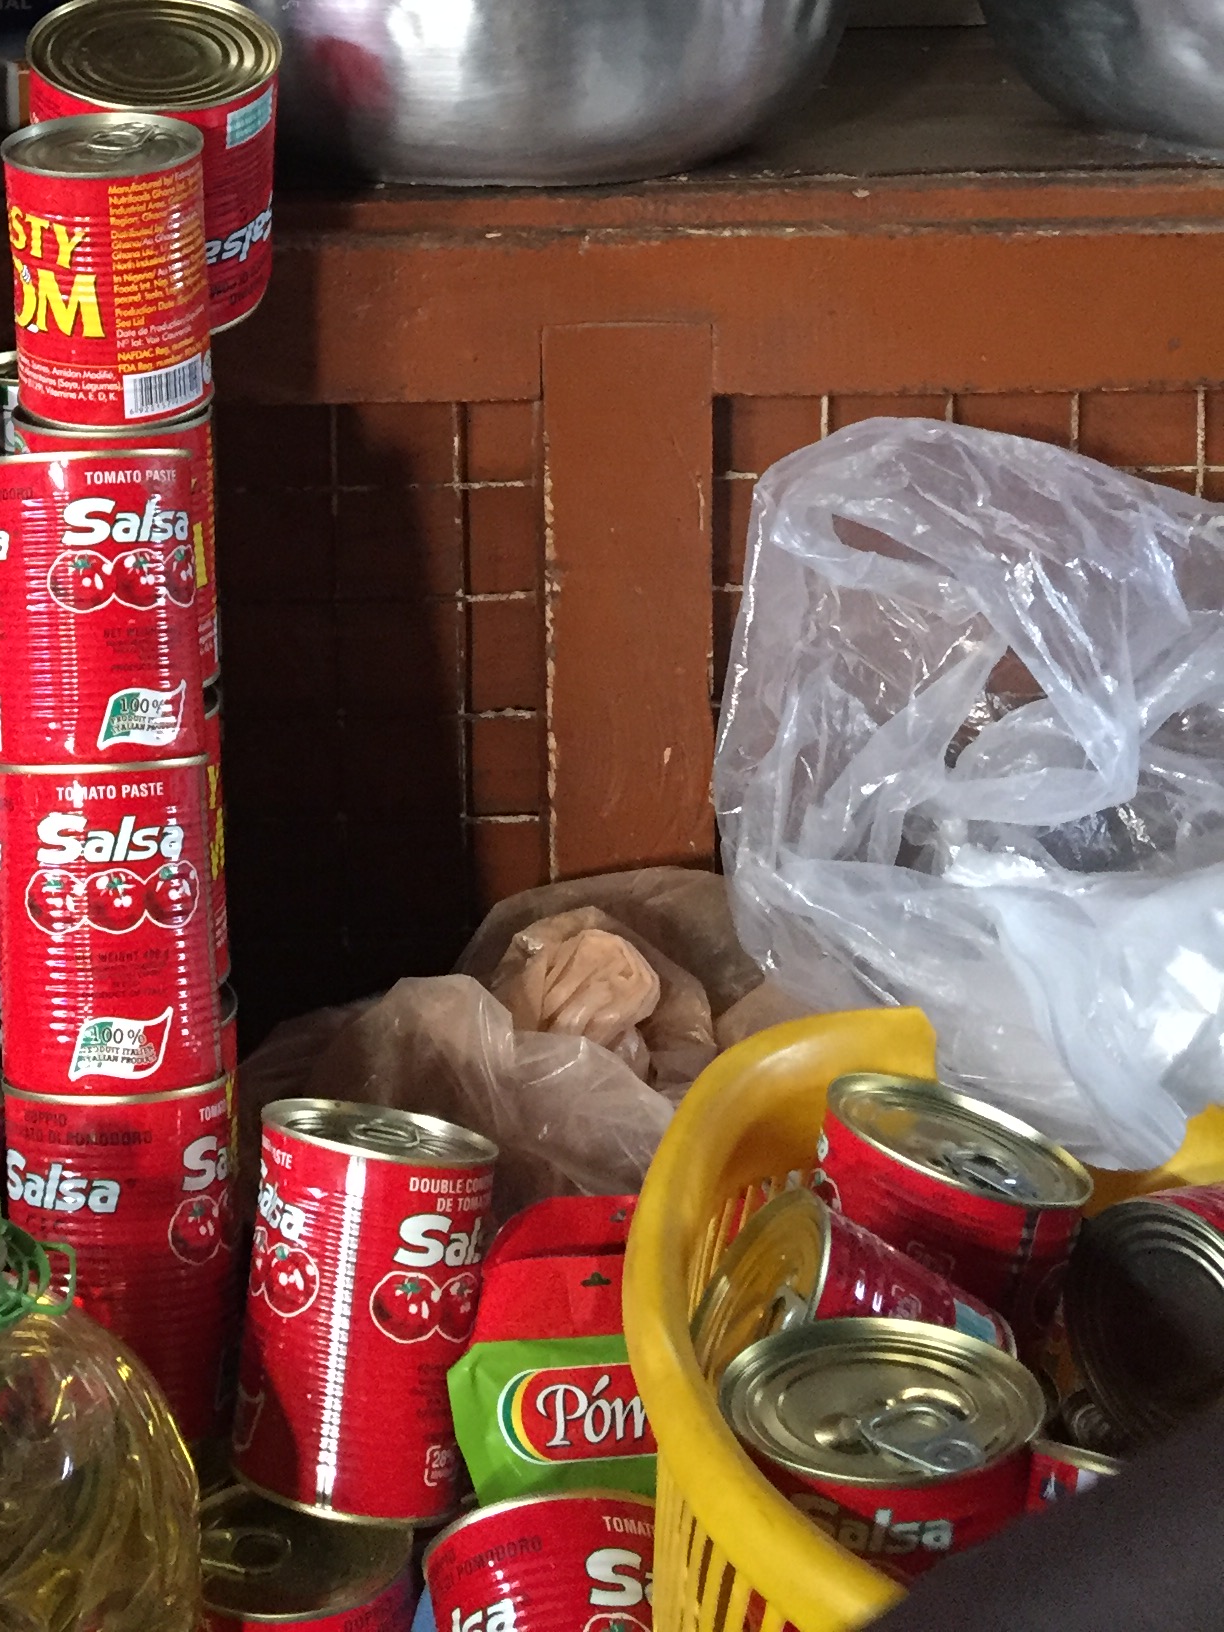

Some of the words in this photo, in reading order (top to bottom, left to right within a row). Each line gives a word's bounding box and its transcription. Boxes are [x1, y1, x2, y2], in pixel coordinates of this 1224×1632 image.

[132, 316, 145, 327] Lid
[51, 366, 83, 379] Amidon
[117, 363, 136, 374] FDA
[83, 469, 142, 486] TOMATO
[145, 468, 178, 483] PASTE
[60, 492, 190, 547] Salsa
[121, 781, 165, 798] PASTE
[36, 812, 185, 866] Salsa
[65, 1128, 153, 1146] POMODORO
[6, 1147, 122, 1214] Salsa
[408, 1174, 463, 1195] DOUBLE
[435, 1195, 454, 1214] DE
[788, 1493, 954, 1553] Salsa
